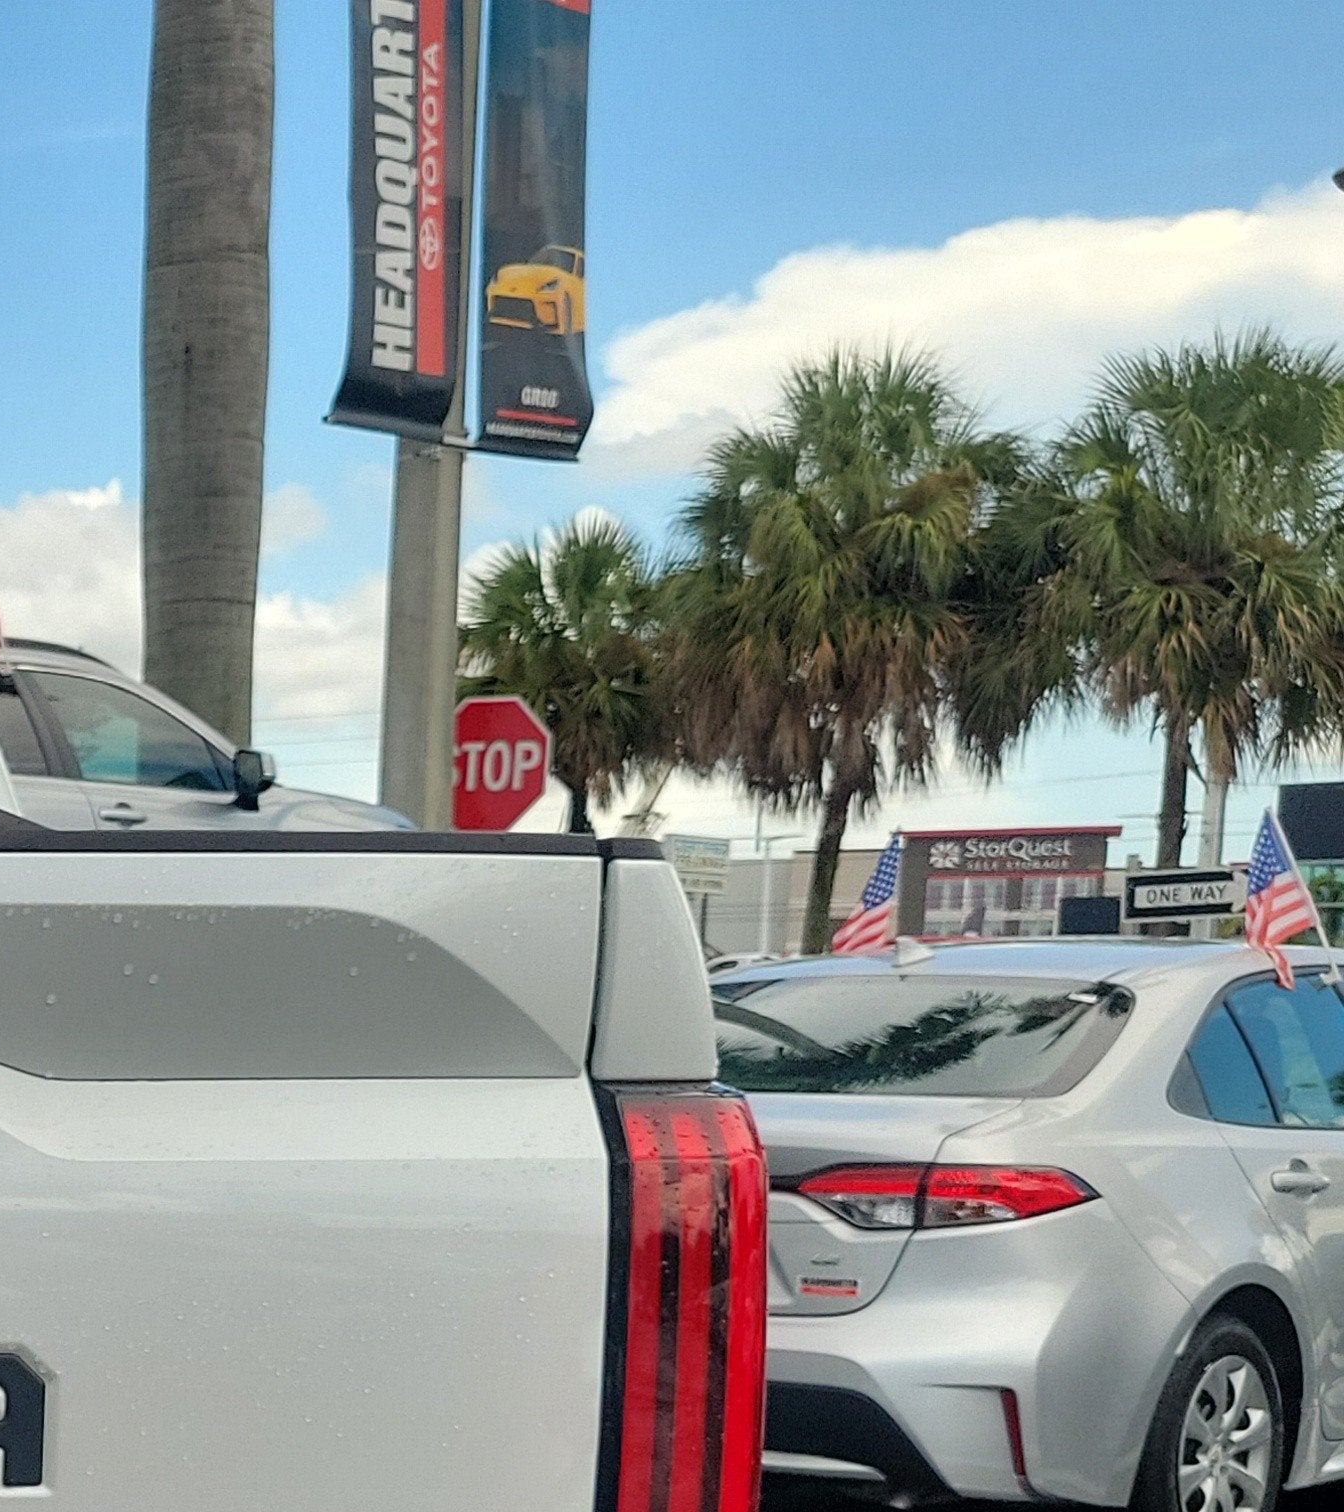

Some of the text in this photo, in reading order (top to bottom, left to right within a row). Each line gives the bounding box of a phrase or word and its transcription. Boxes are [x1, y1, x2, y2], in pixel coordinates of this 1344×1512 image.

[420, 43, 441, 208] TOYOTA
[963, 837, 1072, 862] StorQuest
[1146, 884, 1227, 904] ONE WAY
